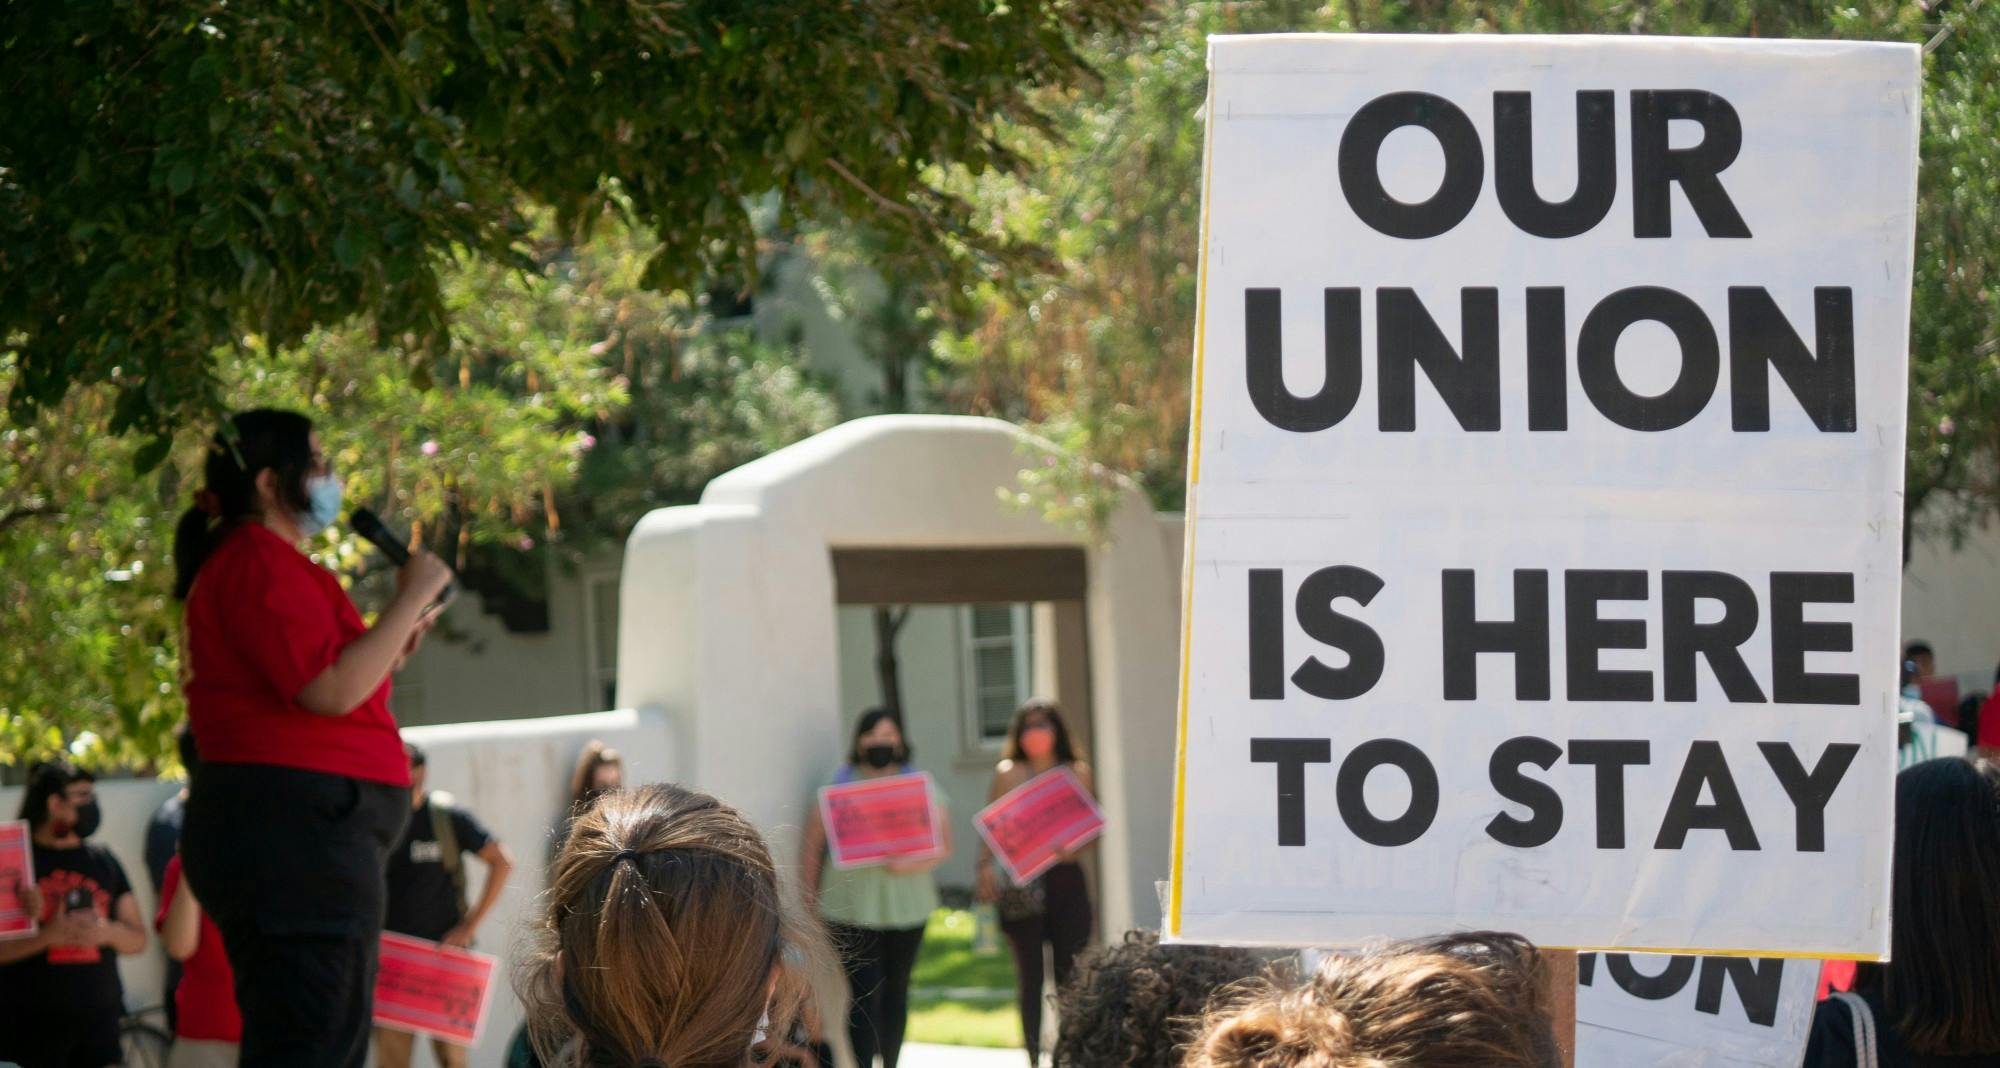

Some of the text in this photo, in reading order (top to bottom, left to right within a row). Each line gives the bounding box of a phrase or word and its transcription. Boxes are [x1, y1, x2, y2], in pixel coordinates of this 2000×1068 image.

[1338, 89, 1753, 240] OUR
[1245, 285, 1857, 433] UNION
[1248, 565, 1861, 706] IS HERE
[1250, 735, 1861, 853] TO STAY
